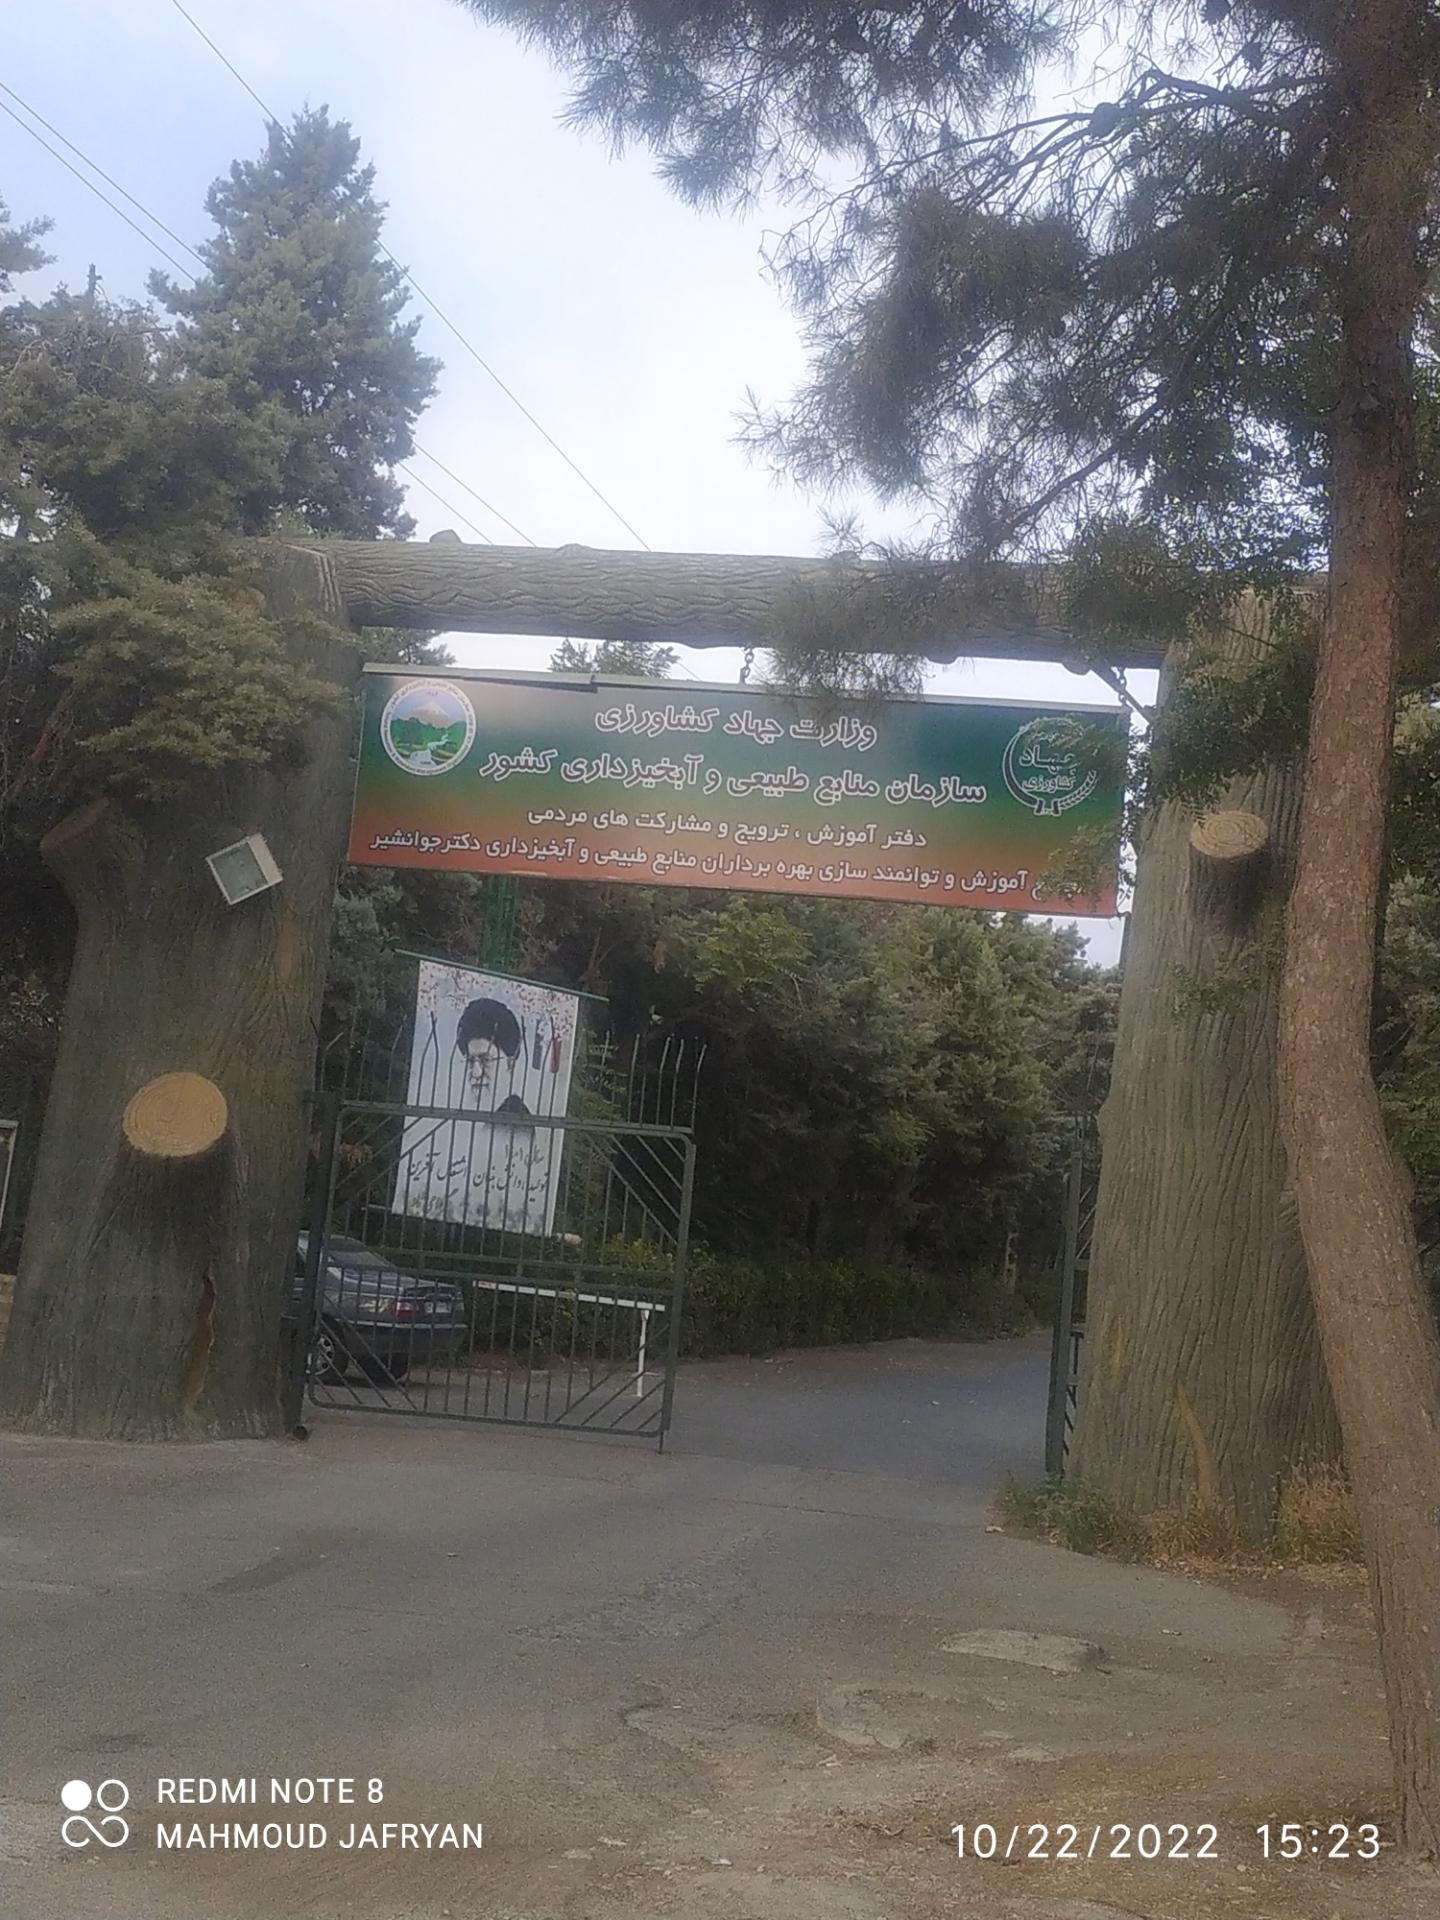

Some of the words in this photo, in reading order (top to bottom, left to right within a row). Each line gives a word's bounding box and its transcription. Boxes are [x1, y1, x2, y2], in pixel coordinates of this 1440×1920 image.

[595, 704, 719, 737] کشاورزی
[723, 711, 784, 744] جهاد
[790, 715, 877, 751] وزارت
[479, 747, 557, 781] کشور
[561, 753, 703, 790] آبخیزداری
[704, 768, 722, 794] و
[727, 766, 809, 797] طبیعی
[814, 769, 880, 806] منابع
[885, 774, 987, 807] سازمان
[528, 808, 587, 826] مردمی
[593, 809, 629, 828] های
[635, 812, 711, 835] مشارکت
[718, 820, 729, 838] و
[734, 823, 789, 845] ترویج
[807, 823, 877, 847] آموزش
[881, 827, 927, 849] دفتر
[486, 836, 575, 860] آبخیزداری
[578, 846, 589, 864] و
[594, 847, 647, 869] طبیعی
[652, 849, 697, 873] منابع
[701, 853, 770, 877] برداران
[776, 859, 813, 881] بهره
[818, 861, 867, 883] سازی
[873, 865, 940, 889] توانمند
[944, 872, 955, 890] و
[961, 869, 1028, 894] آموزش
